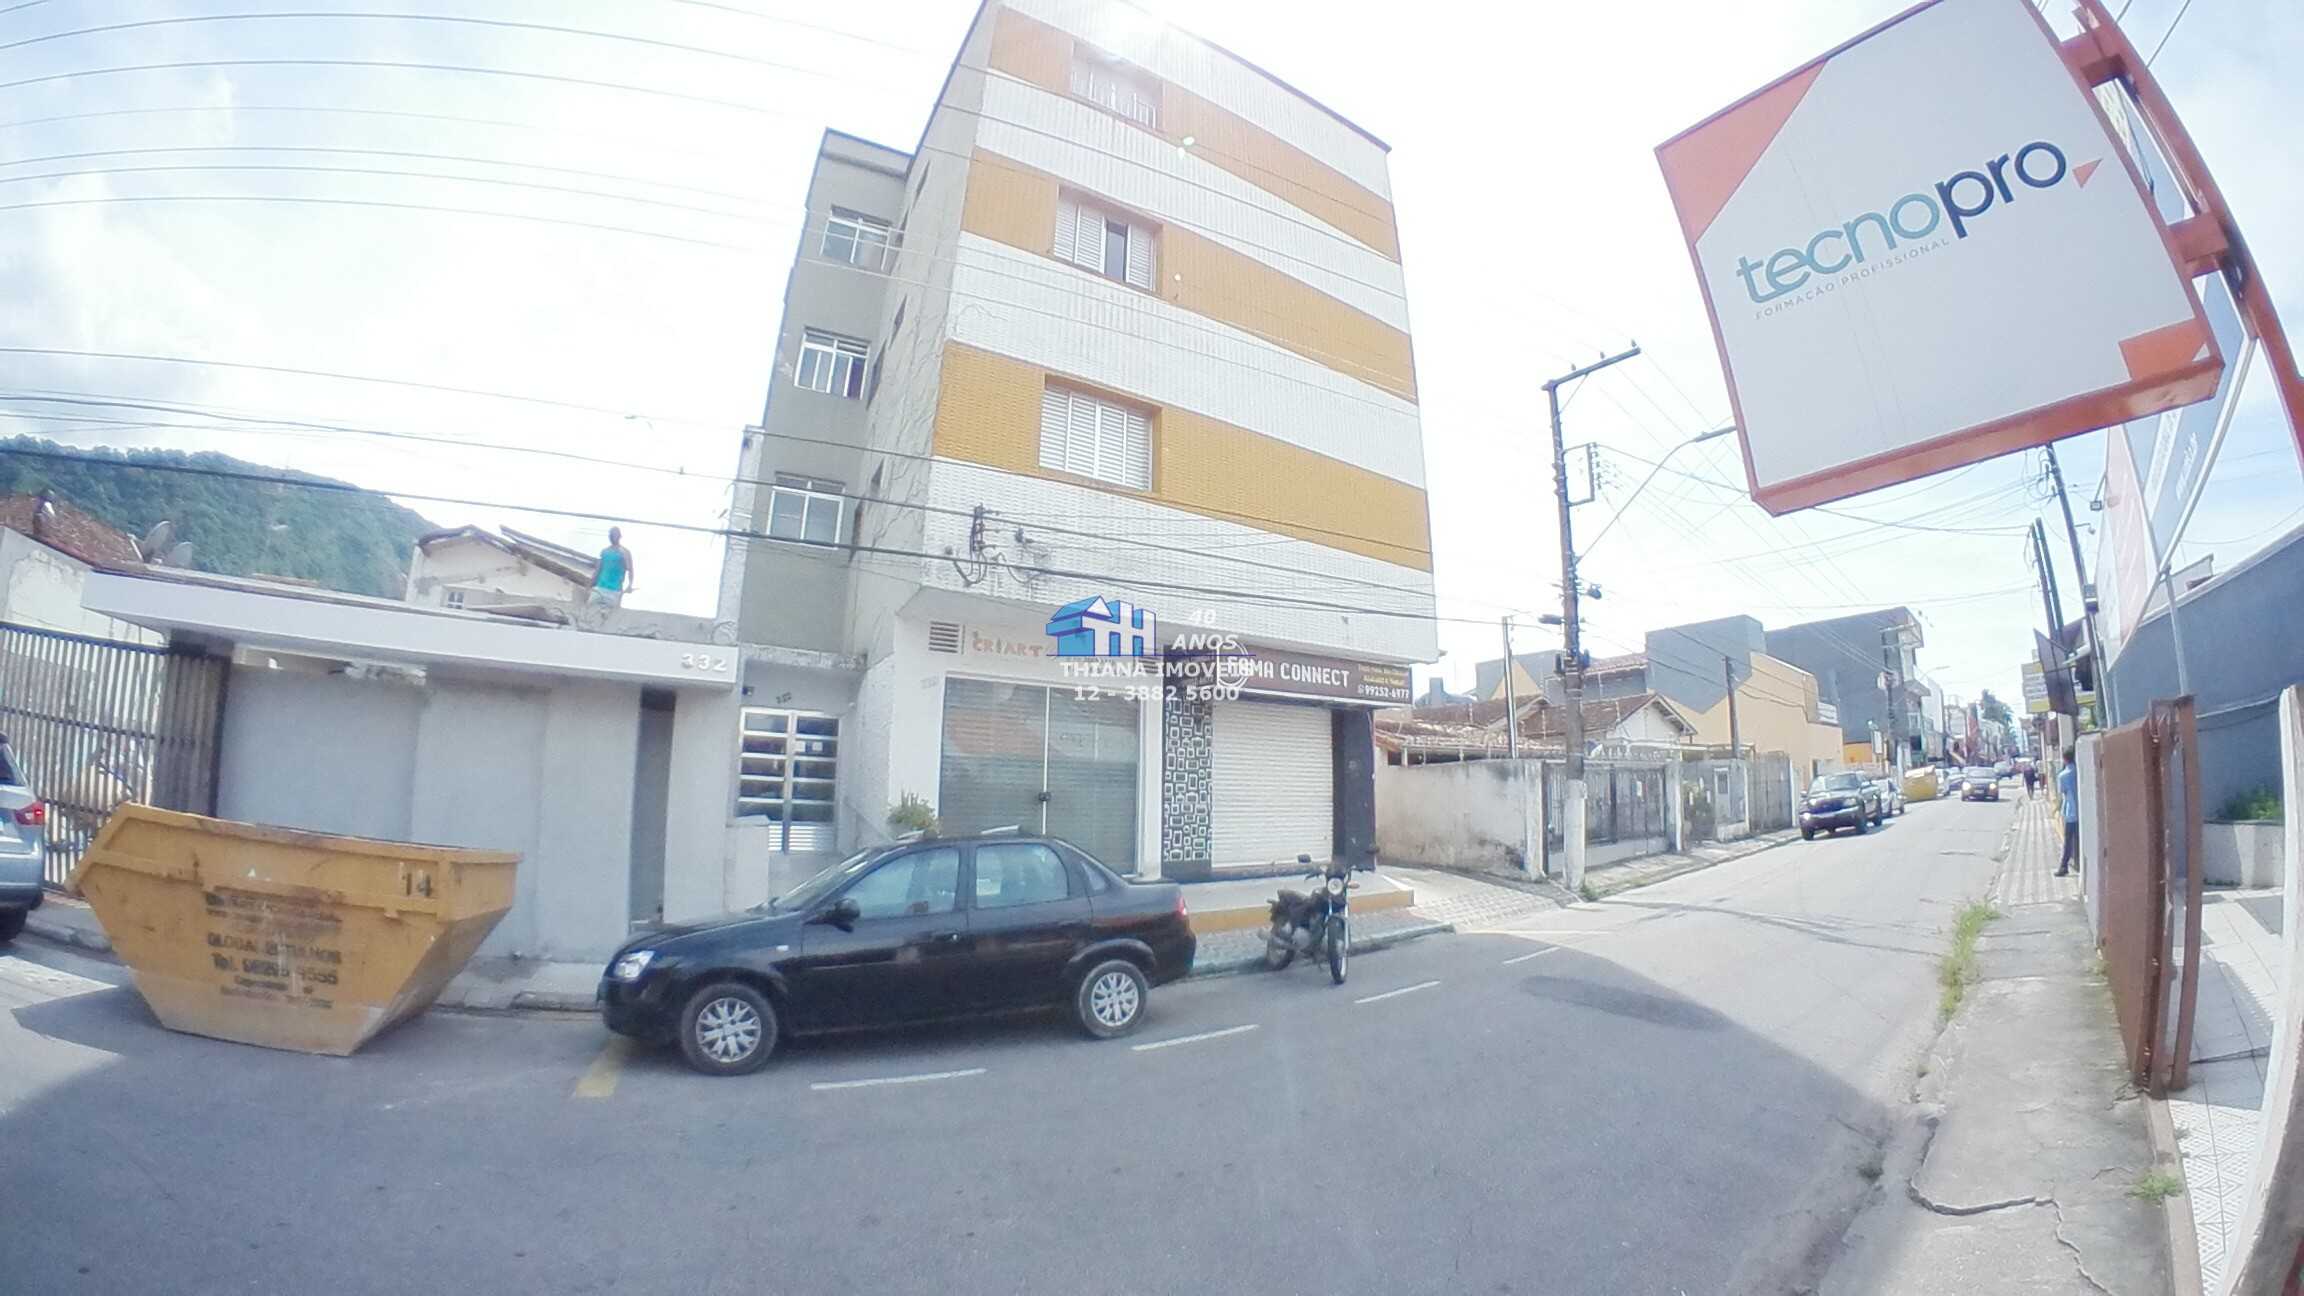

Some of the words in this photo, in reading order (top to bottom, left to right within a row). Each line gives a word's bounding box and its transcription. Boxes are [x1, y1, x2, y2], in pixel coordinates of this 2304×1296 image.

[1736, 141, 2067, 304] tecnopro
[1755, 283, 1835, 320] FORMAÇÃO
[1841, 238, 1950, 288] PROFISSIONAL
[681, 653, 728, 672] 332
[1280, 662, 1350, 688] CONNECT
